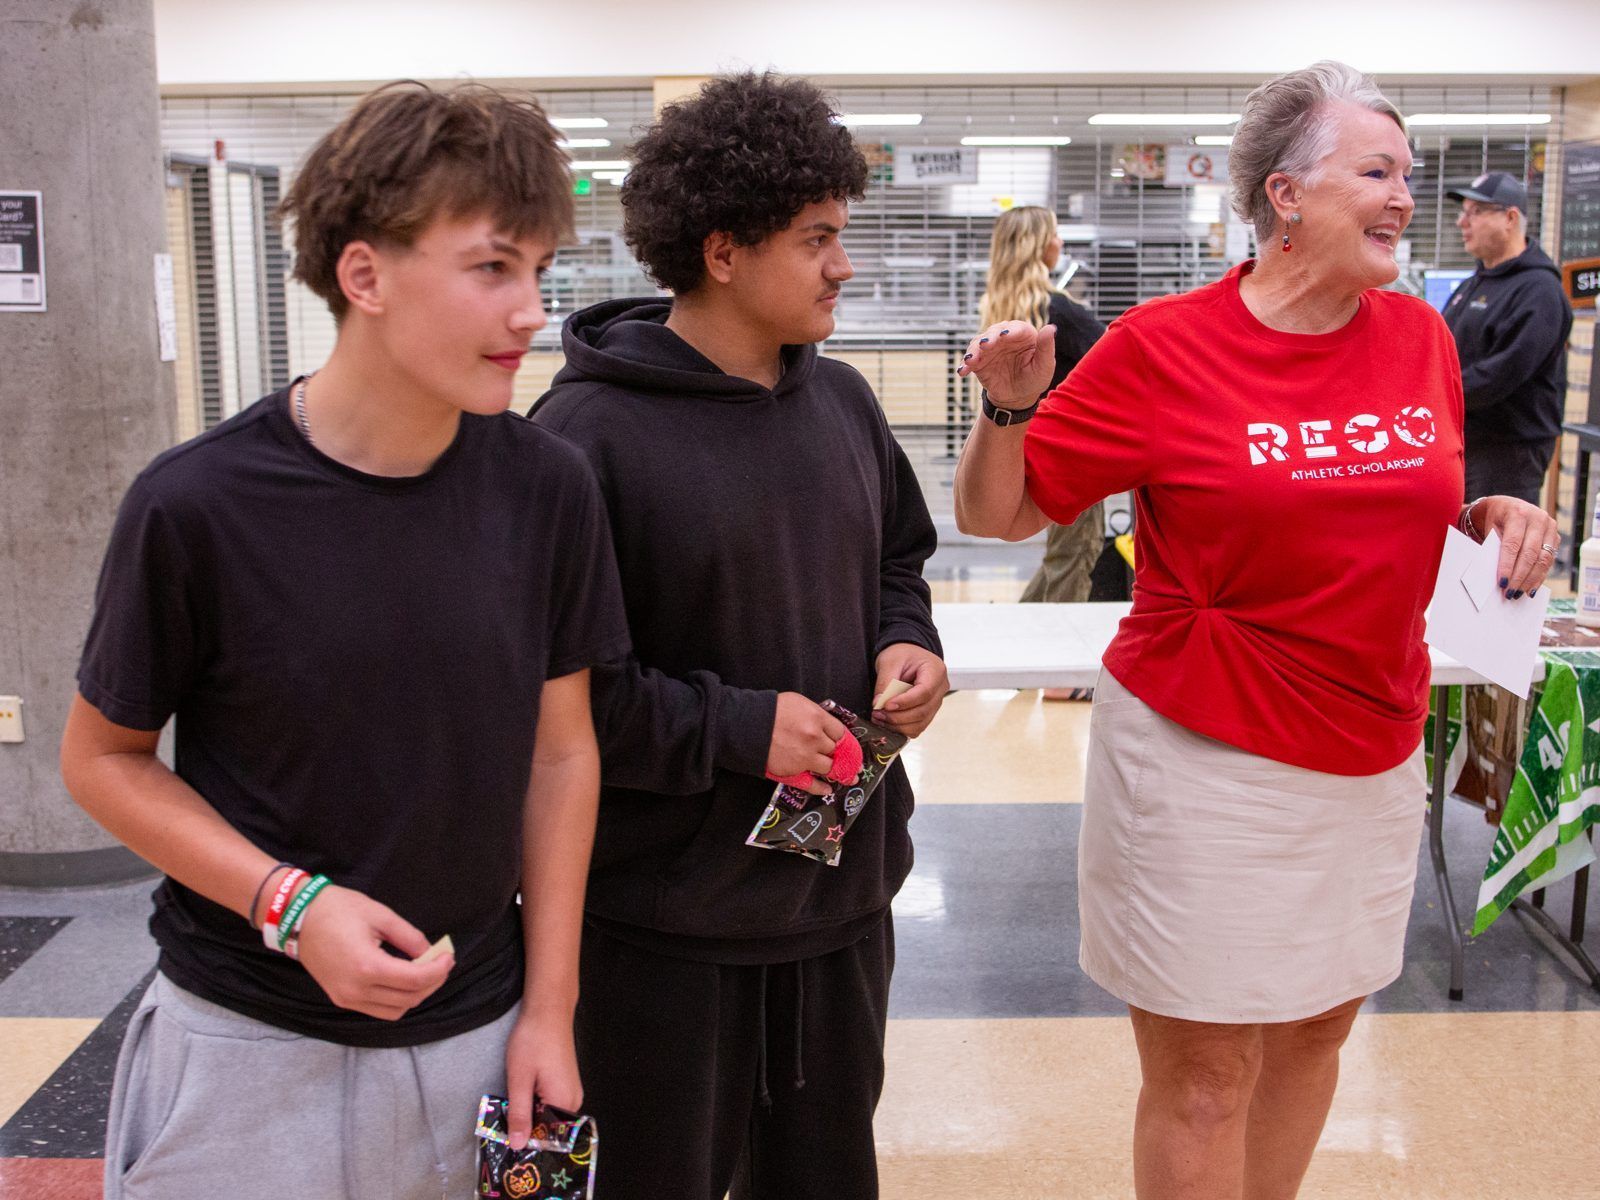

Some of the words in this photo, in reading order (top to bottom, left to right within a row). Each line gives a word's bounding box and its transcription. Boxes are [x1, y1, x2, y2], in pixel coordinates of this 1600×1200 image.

[1291, 465, 1345, 481] ATHLETIC
[1347, 457, 1426, 476] SCHOLARSHIP
[271, 893, 285, 913] NO
[280, 898, 306, 934] ALWAYS
[301, 891, 312, 901] A
